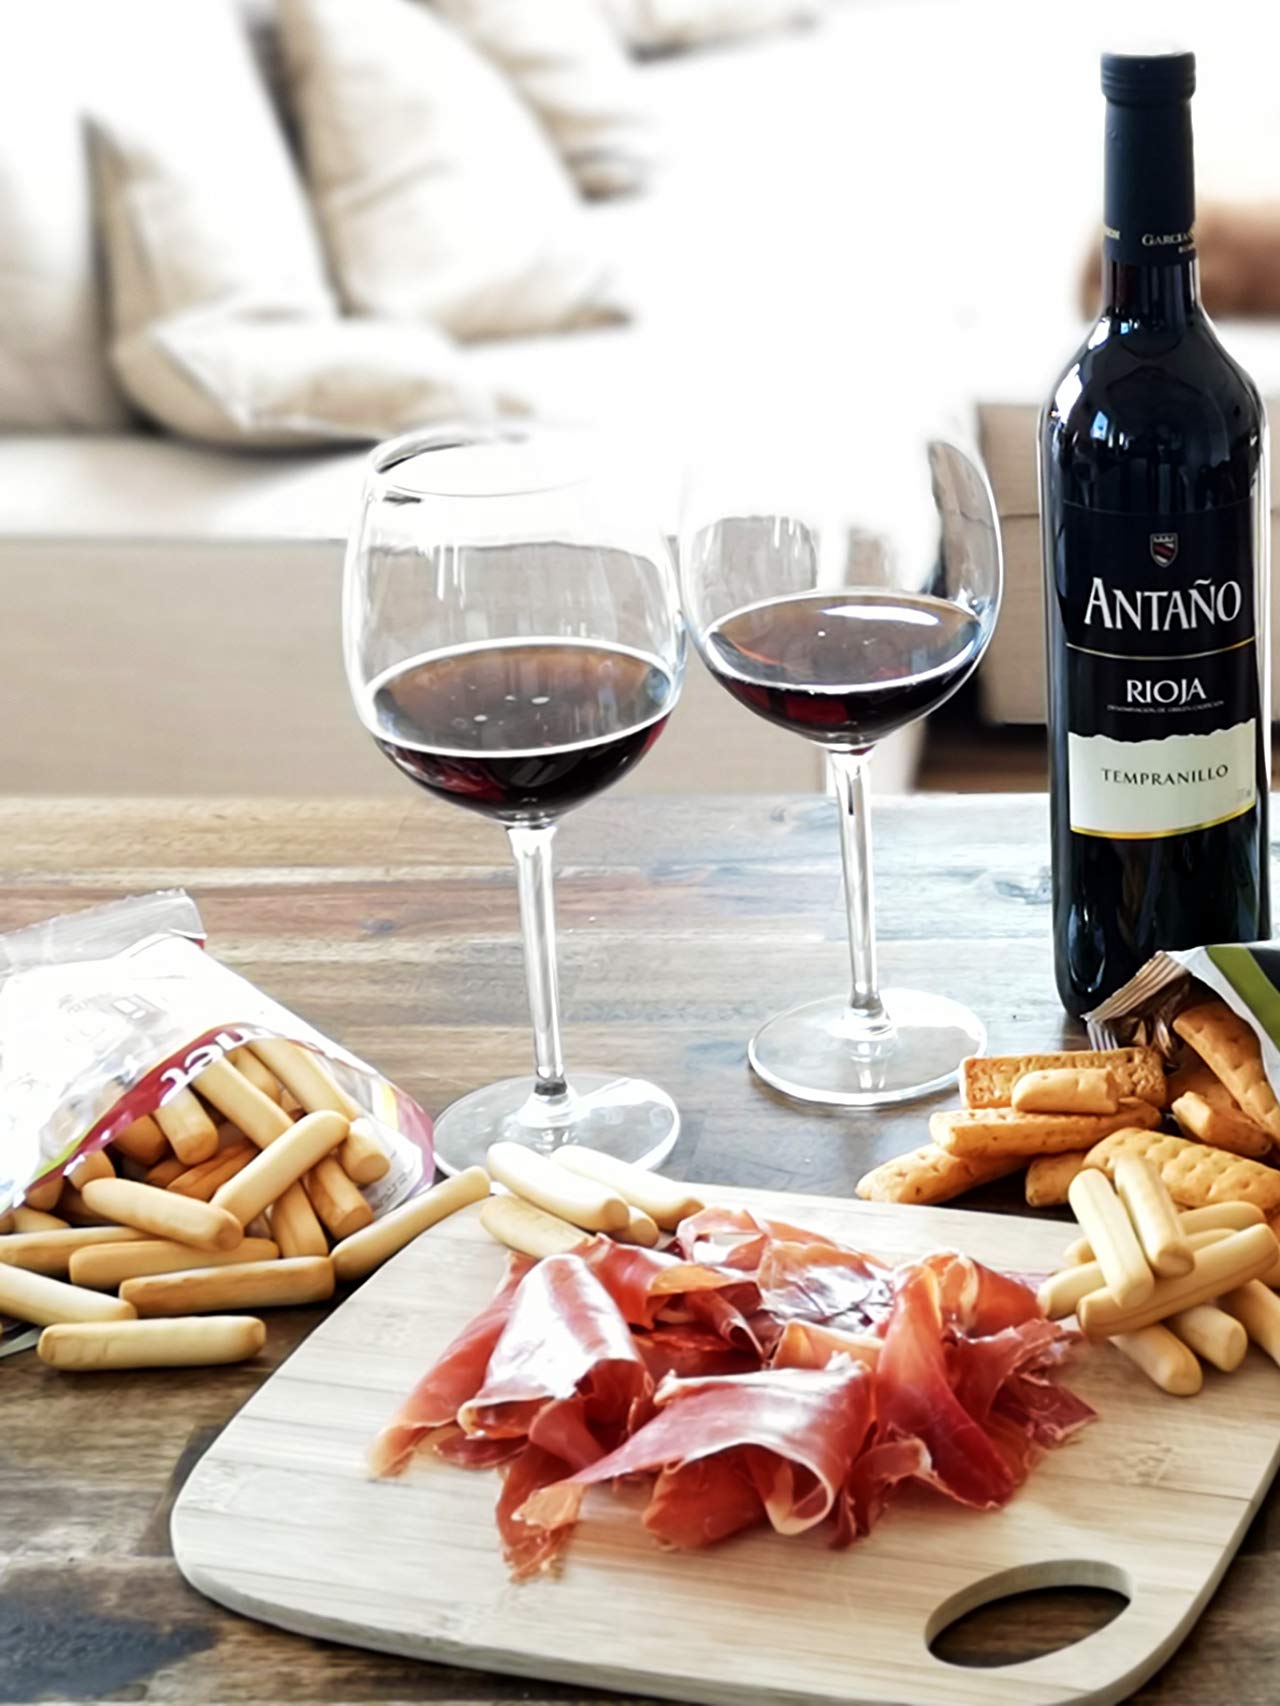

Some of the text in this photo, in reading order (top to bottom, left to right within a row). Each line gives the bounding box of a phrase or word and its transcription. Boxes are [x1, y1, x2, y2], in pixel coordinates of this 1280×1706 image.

[1084, 577, 1242, 631] ANTAÑO
[1126, 677, 1207, 705] RIOJA
[1101, 764, 1228, 786] TEMPRANILLO
